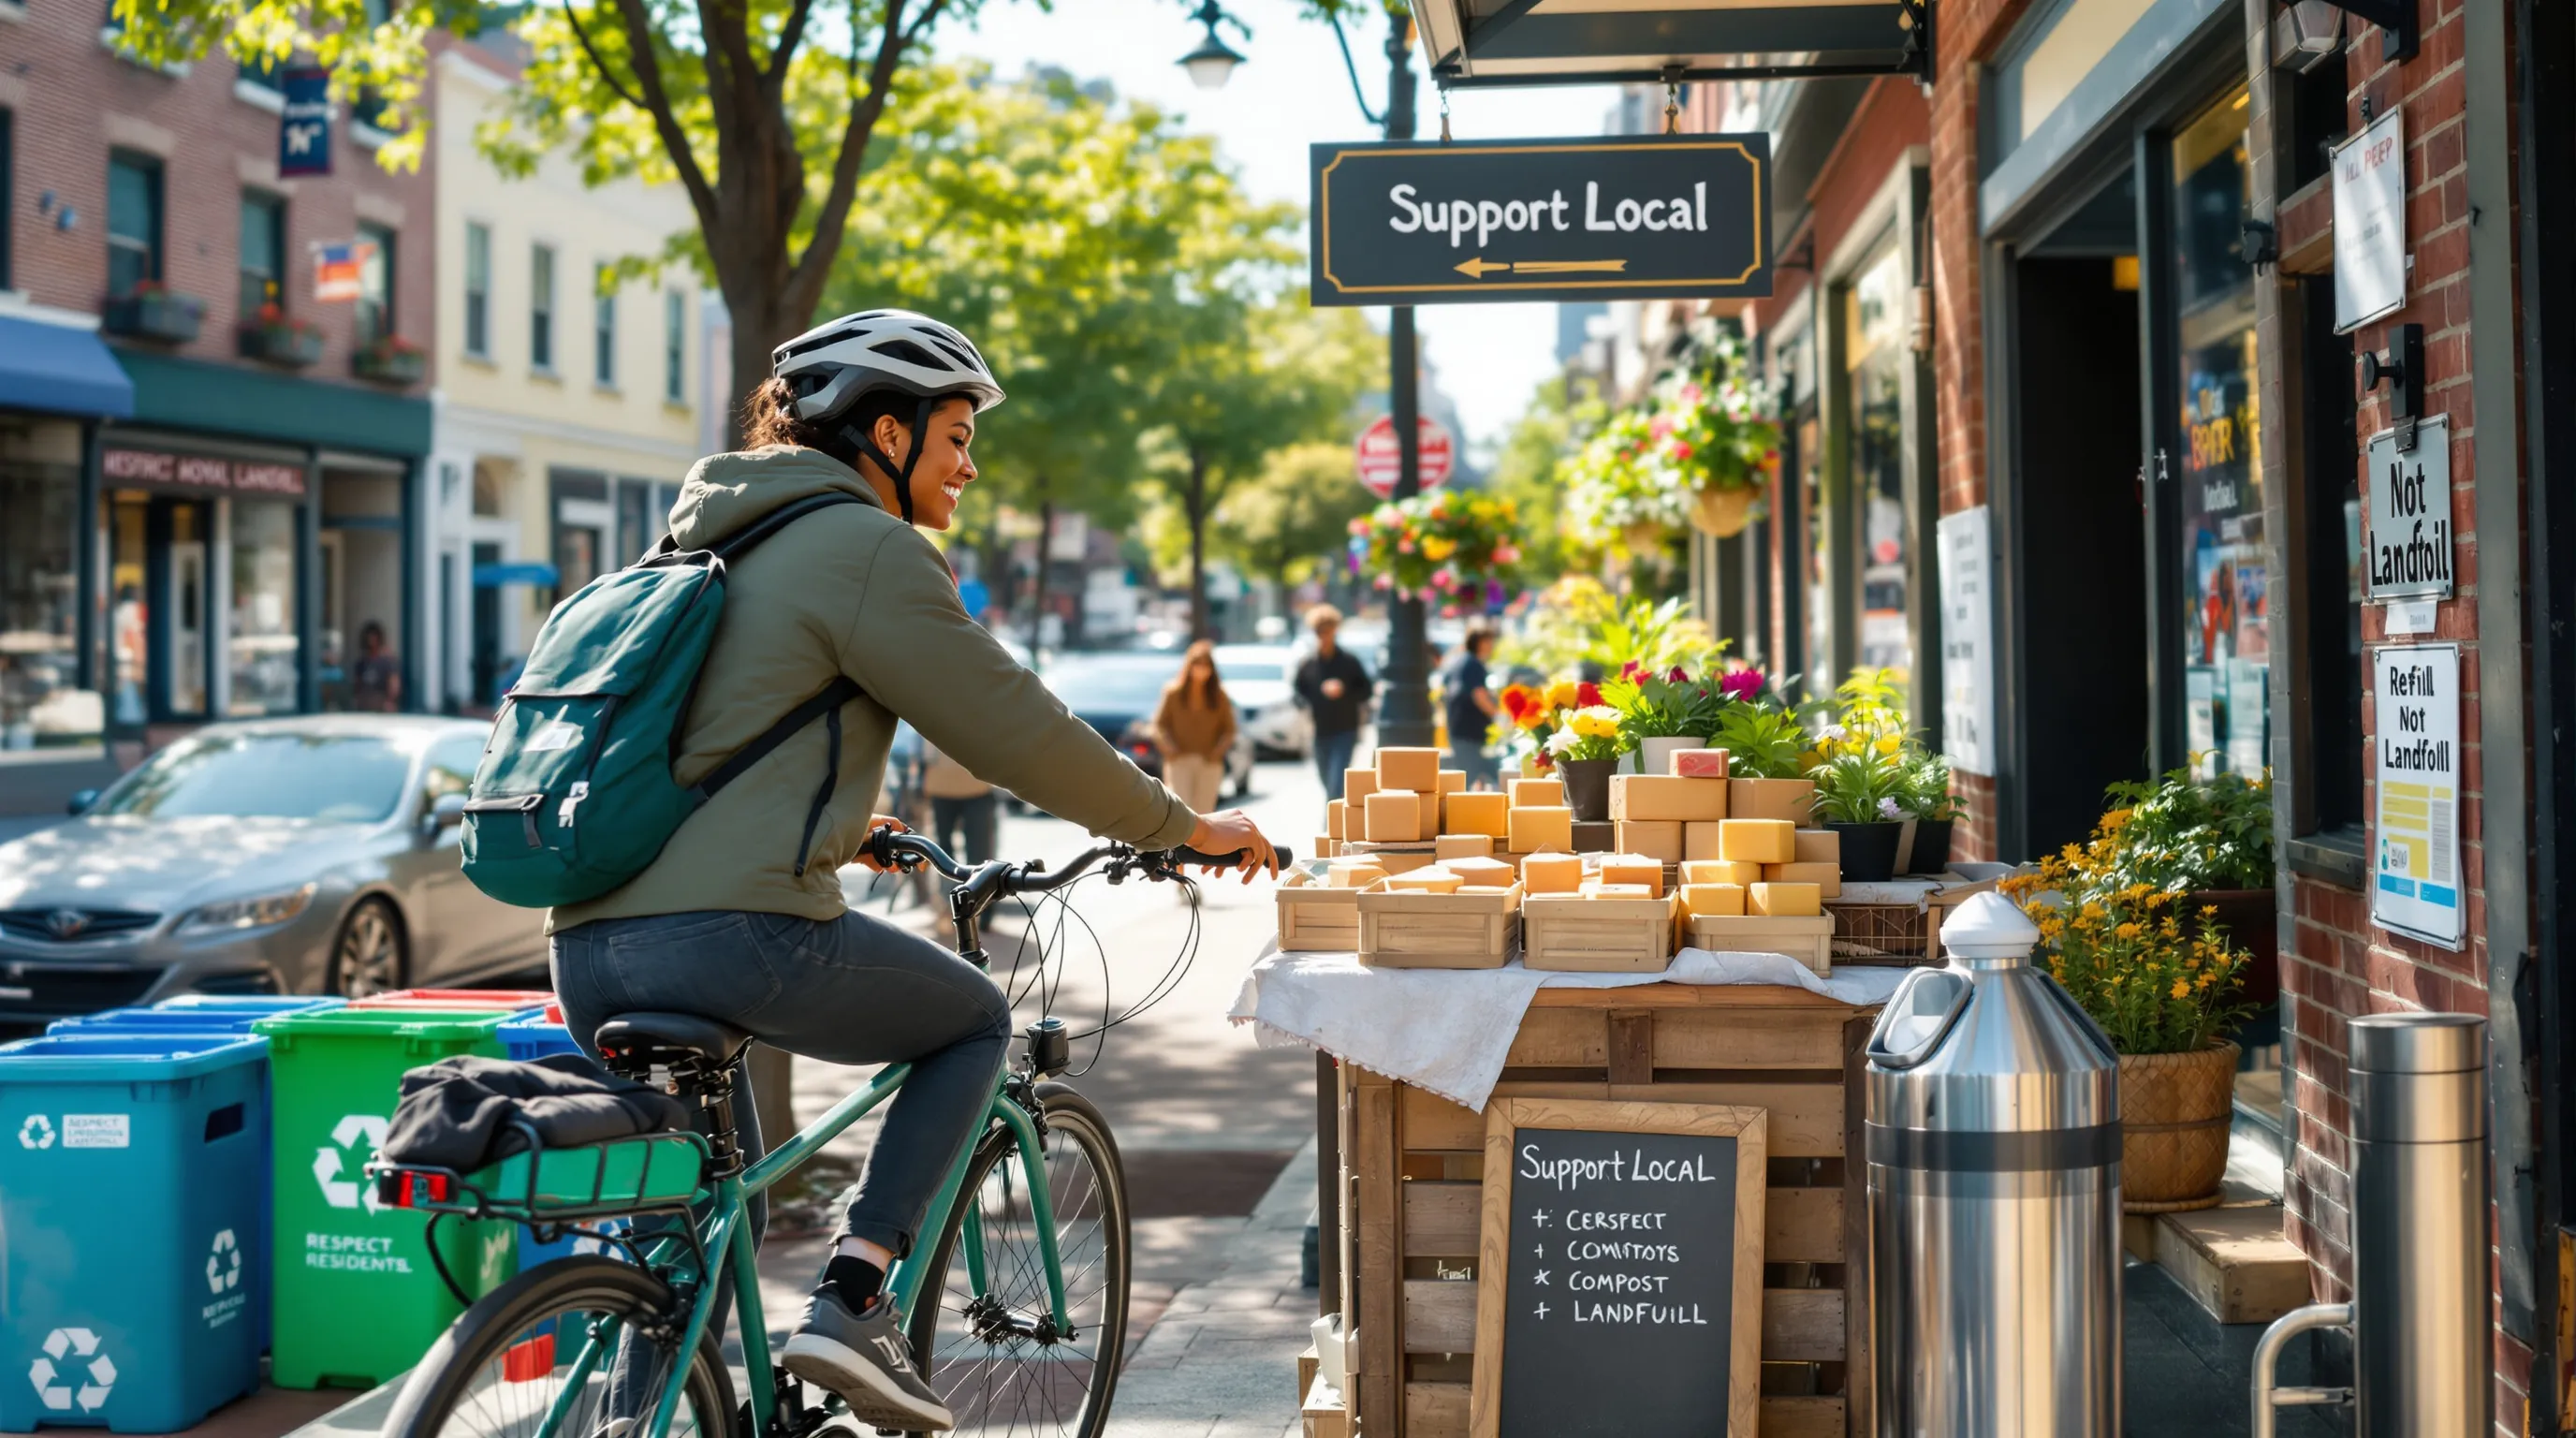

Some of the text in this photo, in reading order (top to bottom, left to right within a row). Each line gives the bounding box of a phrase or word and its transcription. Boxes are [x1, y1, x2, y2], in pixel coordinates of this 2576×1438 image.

[1389, 181, 1708, 248] Support Local
[2390, 462, 2426, 518] Not
[2399, 705, 2426, 733] Not
[1520, 1144, 1717, 1191] Support LOCAL
[1566, 1210, 1667, 1231] CERSPECT
[306, 1232, 393, 1254] RESPECT
[1569, 1270, 1670, 1294] COMPOST
[1574, 1300, 1708, 1324] LANDFUILL
